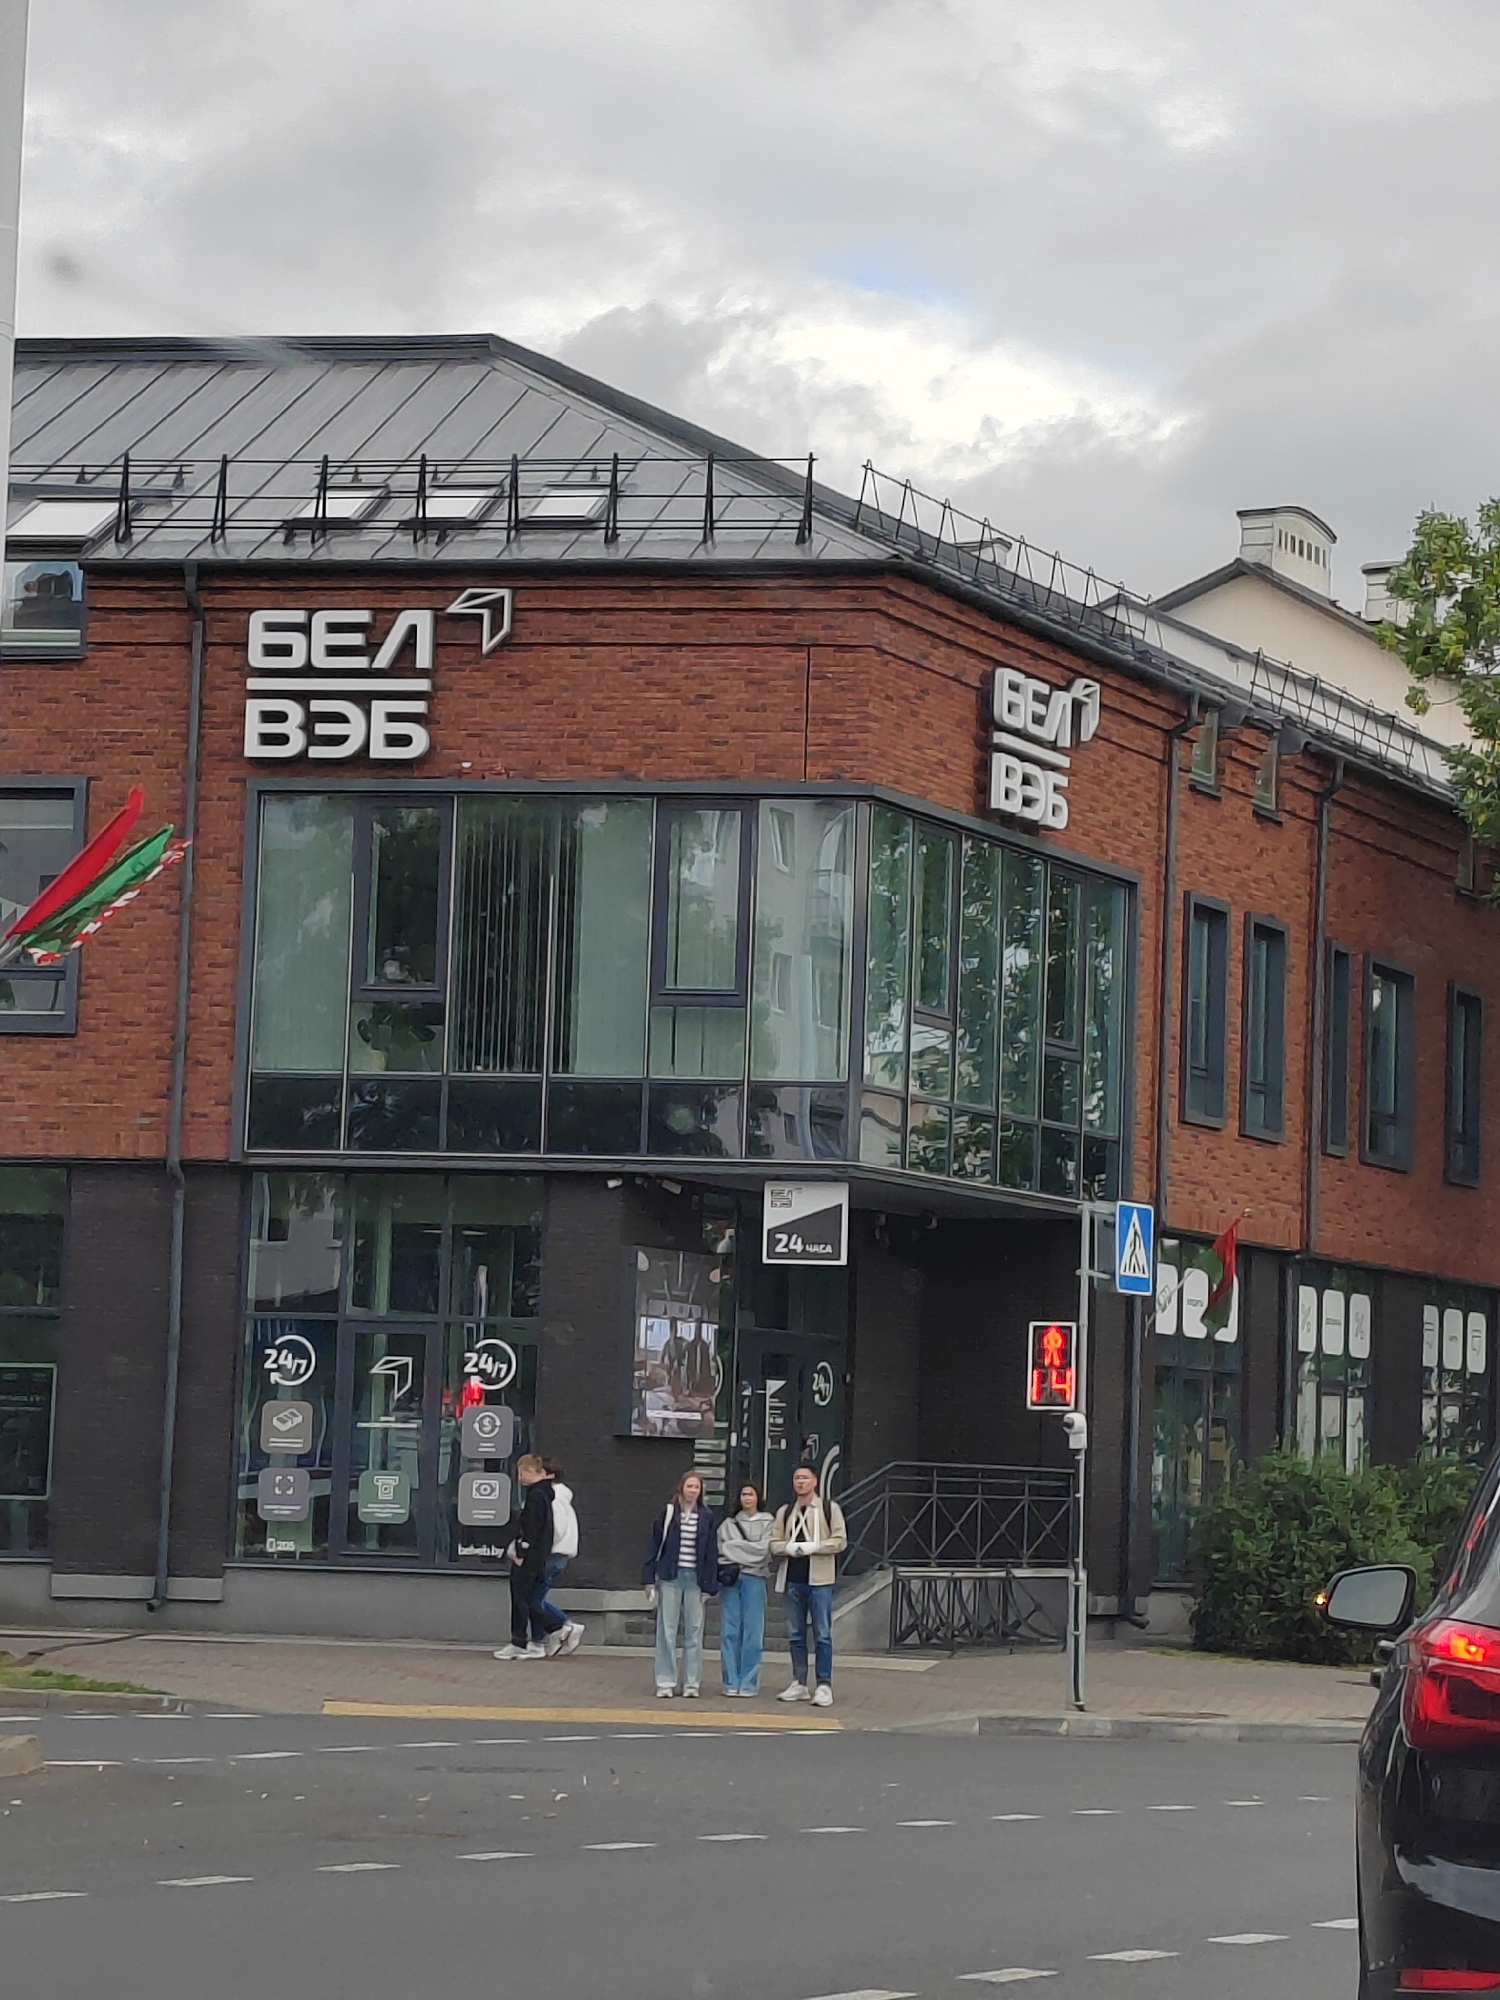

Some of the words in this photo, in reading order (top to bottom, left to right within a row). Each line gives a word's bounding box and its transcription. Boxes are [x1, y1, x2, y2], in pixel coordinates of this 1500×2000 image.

[247, 609, 435, 669] БЕЛ
[243, 698, 431, 760] ВЭБ
[993, 667, 1073, 748] БЕЛ
[990, 752, 1069, 830] ВЭБ
[774, 1233, 804, 1254] 24
[263, 1348, 308, 1375] 24/7
[463, 1352, 508, 1379] 24/7
[1031, 1368, 1073, 1402] 14
